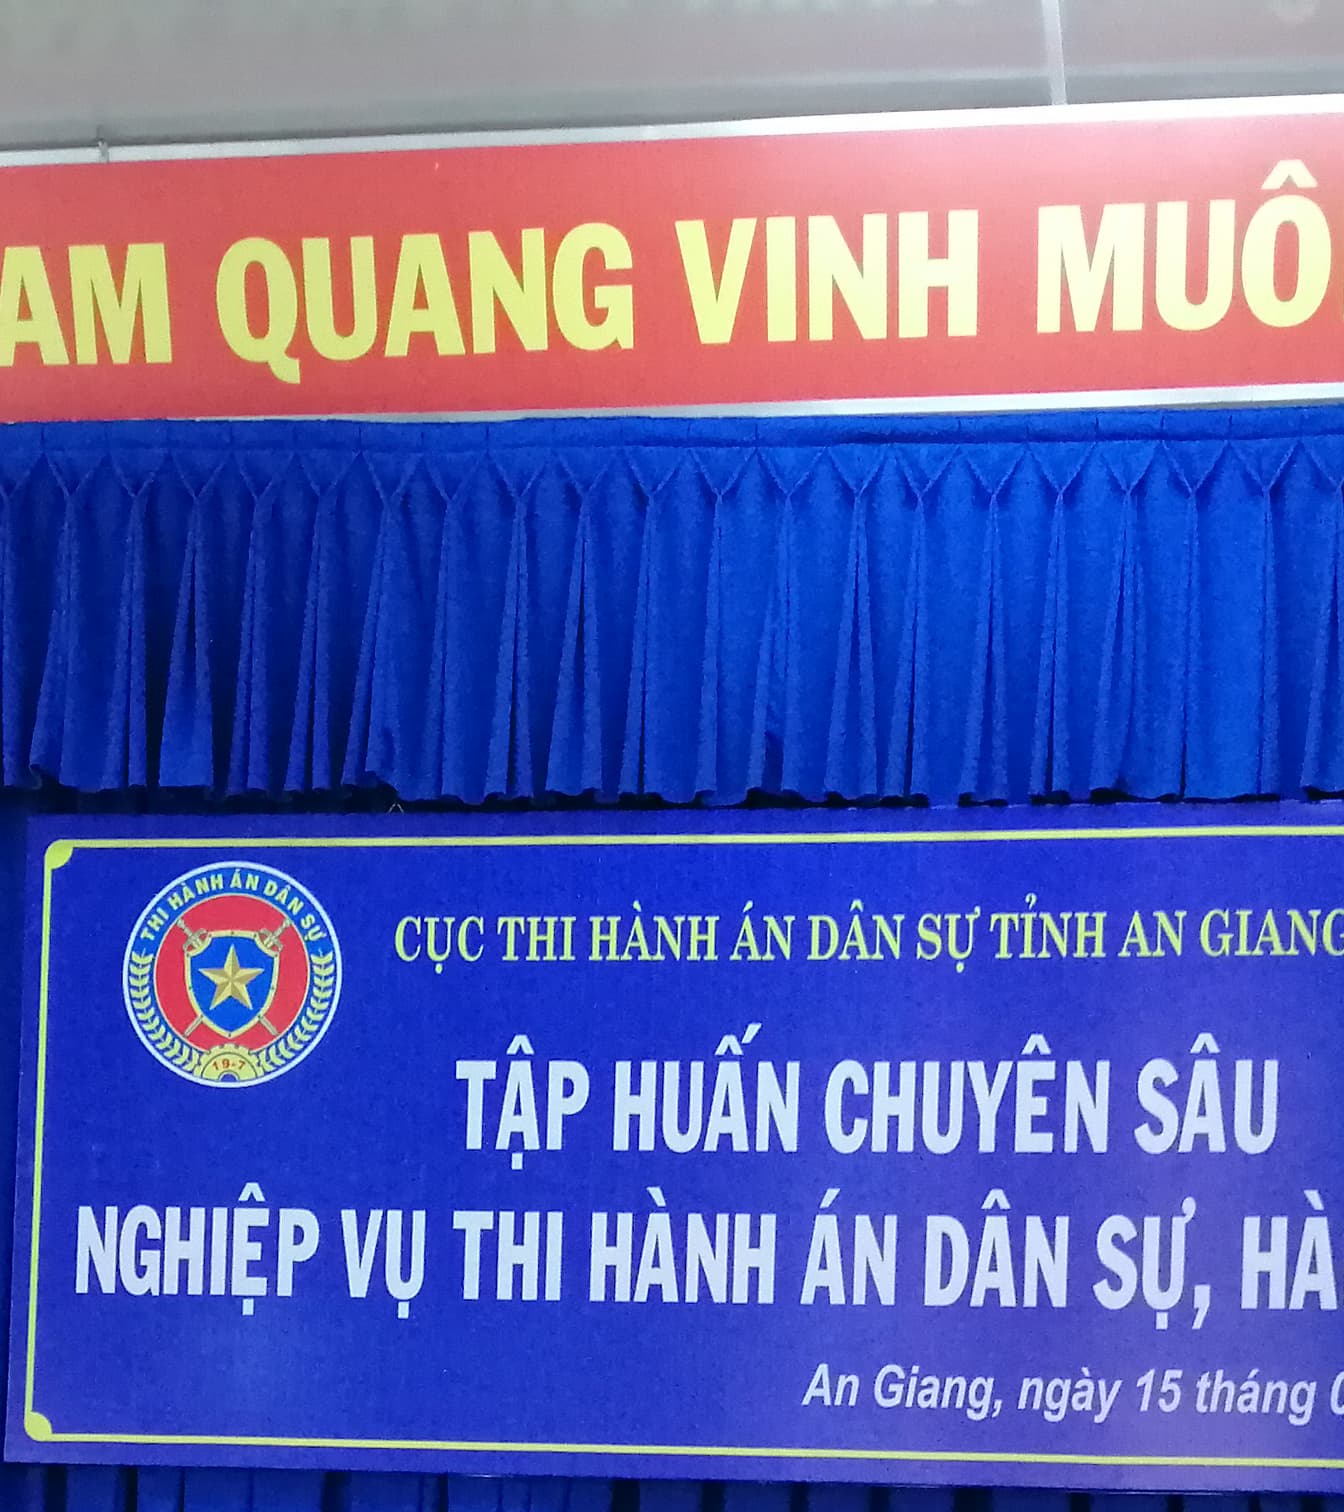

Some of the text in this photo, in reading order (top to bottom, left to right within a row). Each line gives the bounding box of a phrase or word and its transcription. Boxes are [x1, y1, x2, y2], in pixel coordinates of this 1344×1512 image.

[216, 222, 635, 385] QUANG
[675, 208, 981, 345] VINH
[140, 906, 170, 941] THI
[167, 873, 224, 912] HÀNH
[229, 868, 260, 891] ÁN
[263, 878, 305, 916] DÂN
[394, 914, 485, 975] CỤC
[497, 915, 577, 961] THI
[588, 899, 719, 961] HÀNH
[729, 900, 796, 961] ÁN
[807, 898, 905, 961] DÂN
[916, 905, 981, 973] SỰ
[989, 892, 1107, 959] TỈNH
[1118, 909, 1188, 958] AN
[455, 1022, 1279, 1167] TẬP HUẤN CHUYÊN SÂU
[75, 1182, 320, 1315] NGHIỆP
[340, 1208, 426, 1319] VỤ
[452, 1210, 564, 1301] THI
[589, 1186, 777, 1305] HÀNH
[799, 1187, 898, 1306] ÁN
[923, 1188, 1070, 1308] DÂN
[1092, 1195, 1213, 1330] SỰ,
[800, 1362, 860, 1407] An
[873, 1363, 1003, 1422] Giang,
[1017, 1366, 1124, 1424] ngày
[1135, 1367, 1184, 1417] 15
[1195, 1367, 1318, 1427] tháng
